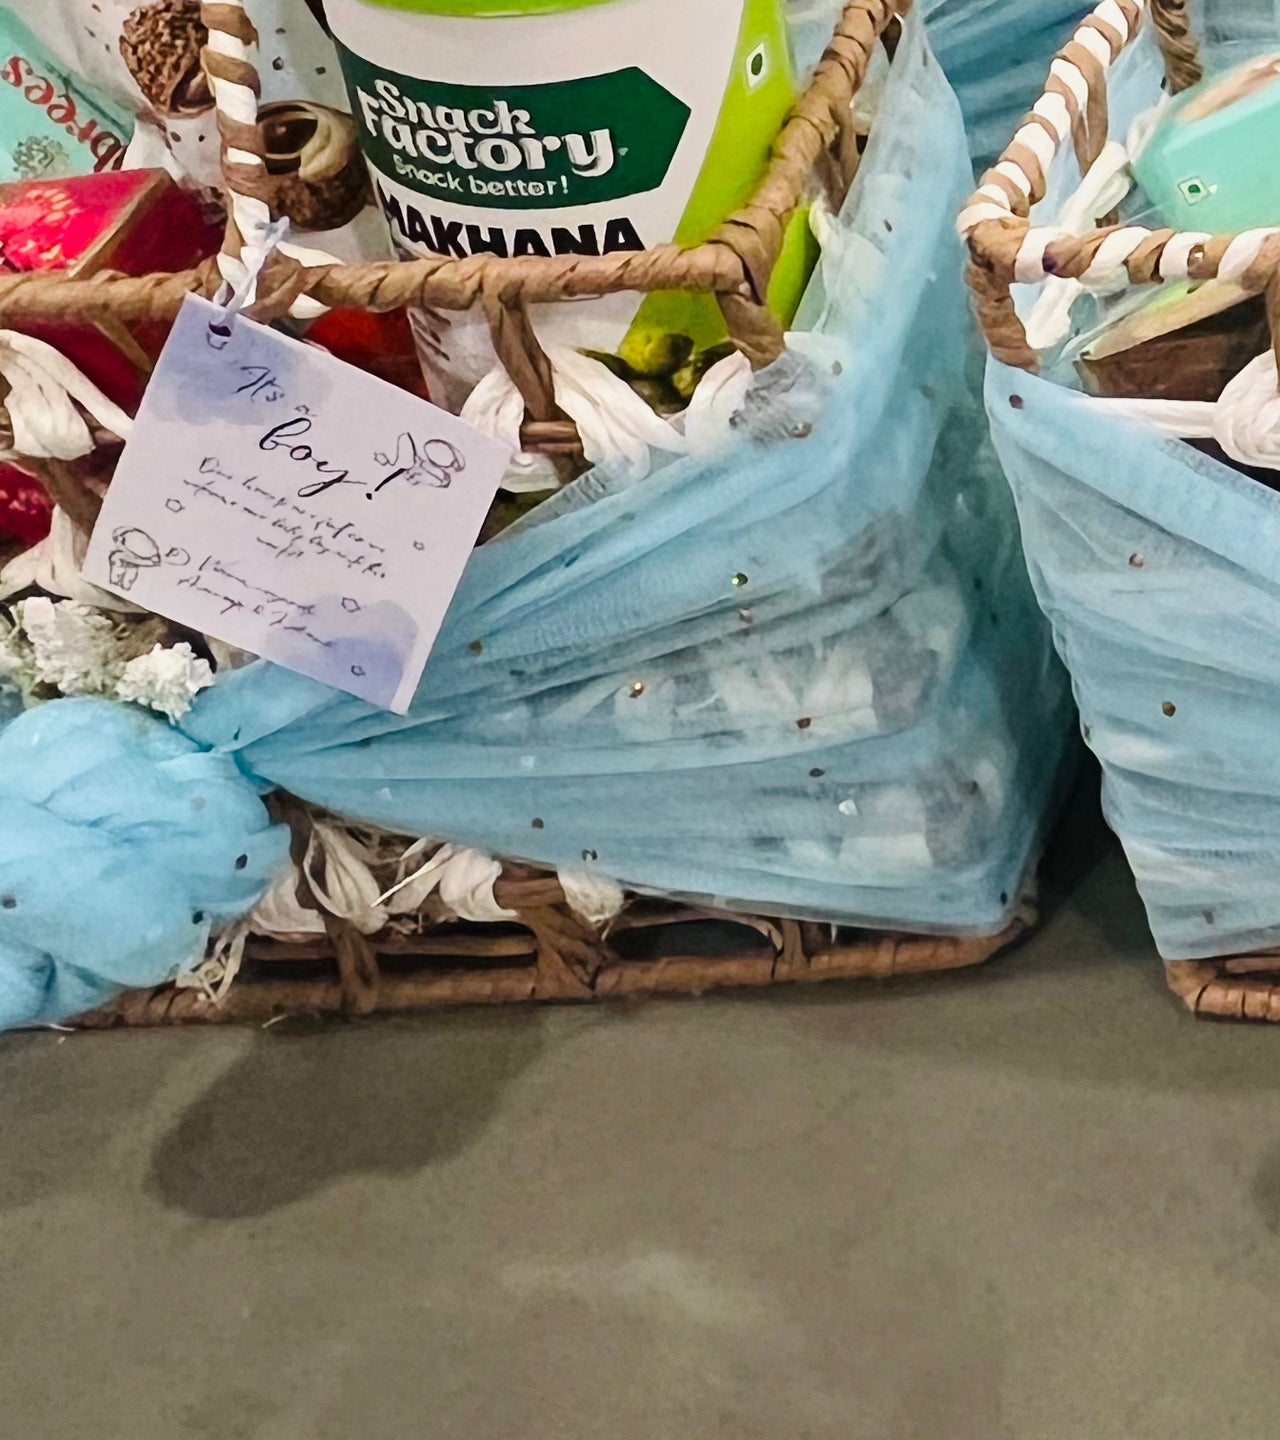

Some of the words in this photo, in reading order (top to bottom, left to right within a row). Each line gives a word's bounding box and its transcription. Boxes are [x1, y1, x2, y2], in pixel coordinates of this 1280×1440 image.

[356, 85, 616, 178] Factory
[373, 78, 537, 135] Snack
[376, 176, 646, 259] MAKHANA
[468, 175, 569, 197] better!
[258, 417, 408, 500] boy!
